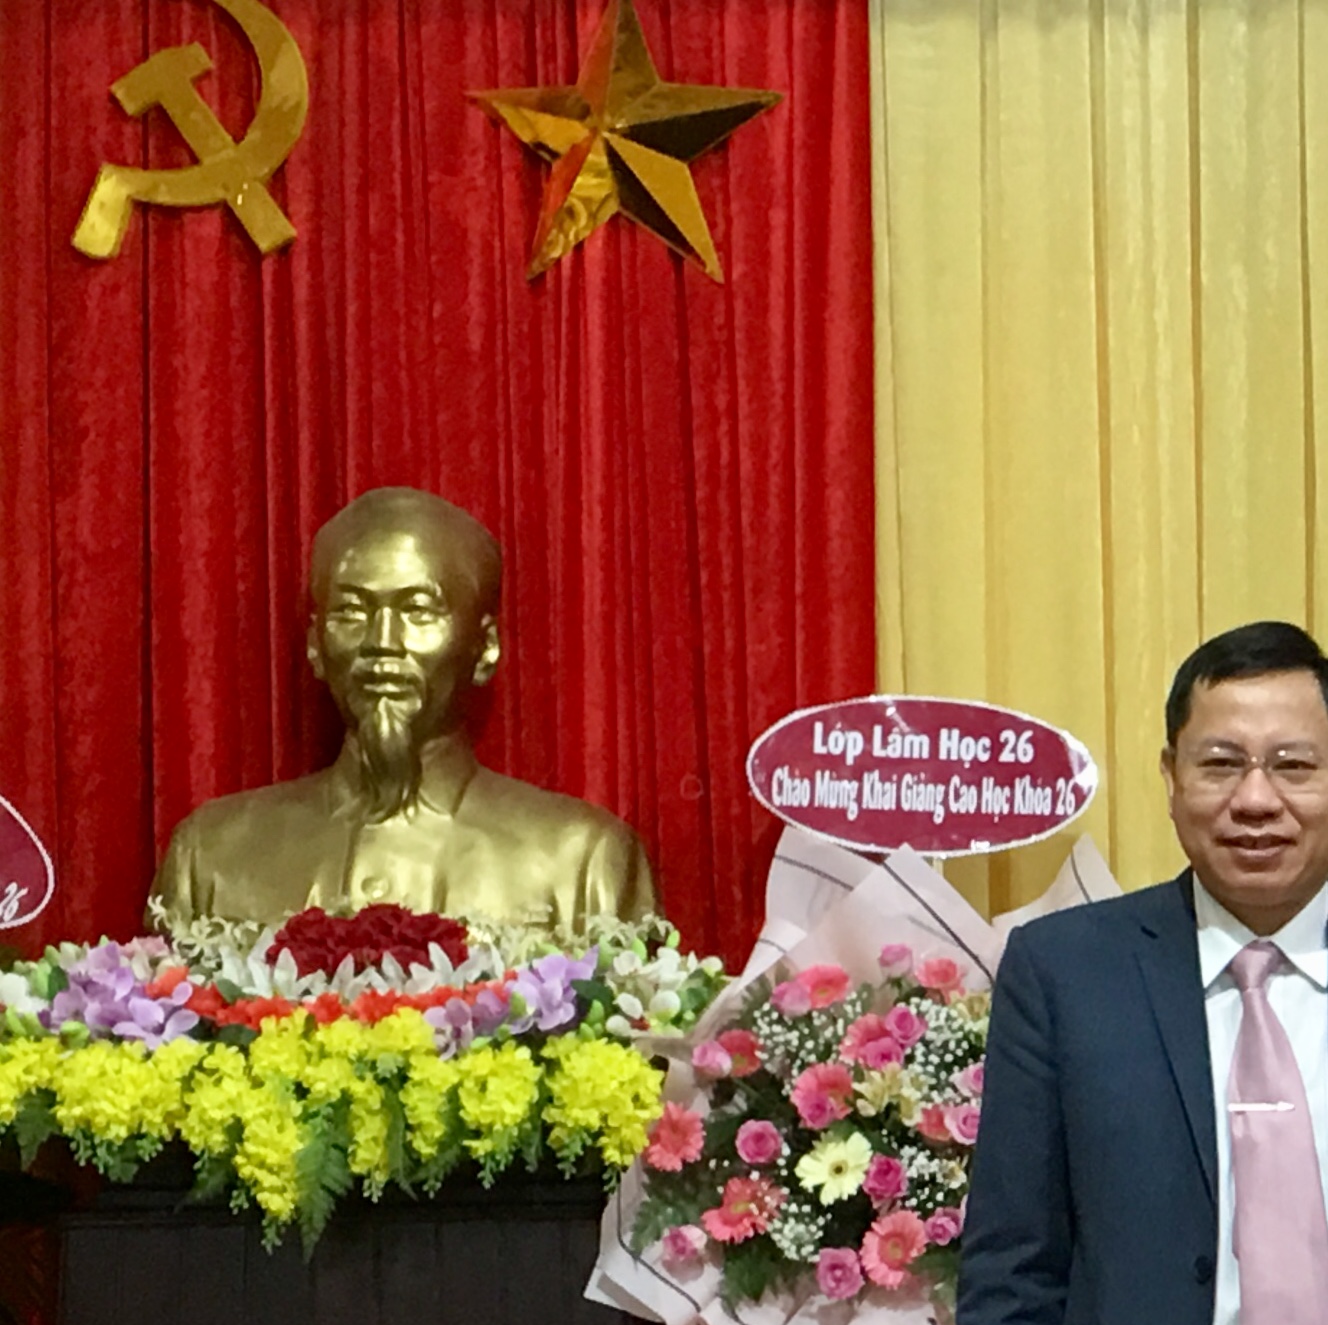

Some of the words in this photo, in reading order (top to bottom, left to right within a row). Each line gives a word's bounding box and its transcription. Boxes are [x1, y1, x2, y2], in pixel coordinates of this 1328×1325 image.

[813, 721, 864, 765] Lớp
[872, 724, 930, 759] Lâm
[938, 727, 992, 769] Học
[998, 729, 1034, 763] 26
[771, 766, 811, 808] Chào
[814, 769, 858, 821] Mừng
[862, 772, 898, 811] Khai
[901, 772, 946, 825] Giảng
[949, 774, 978, 814] Cao
[981, 776, 1011, 823] Học
[1014, 776, 1052, 816] Khóa
[1055, 777, 1076, 816] 26
